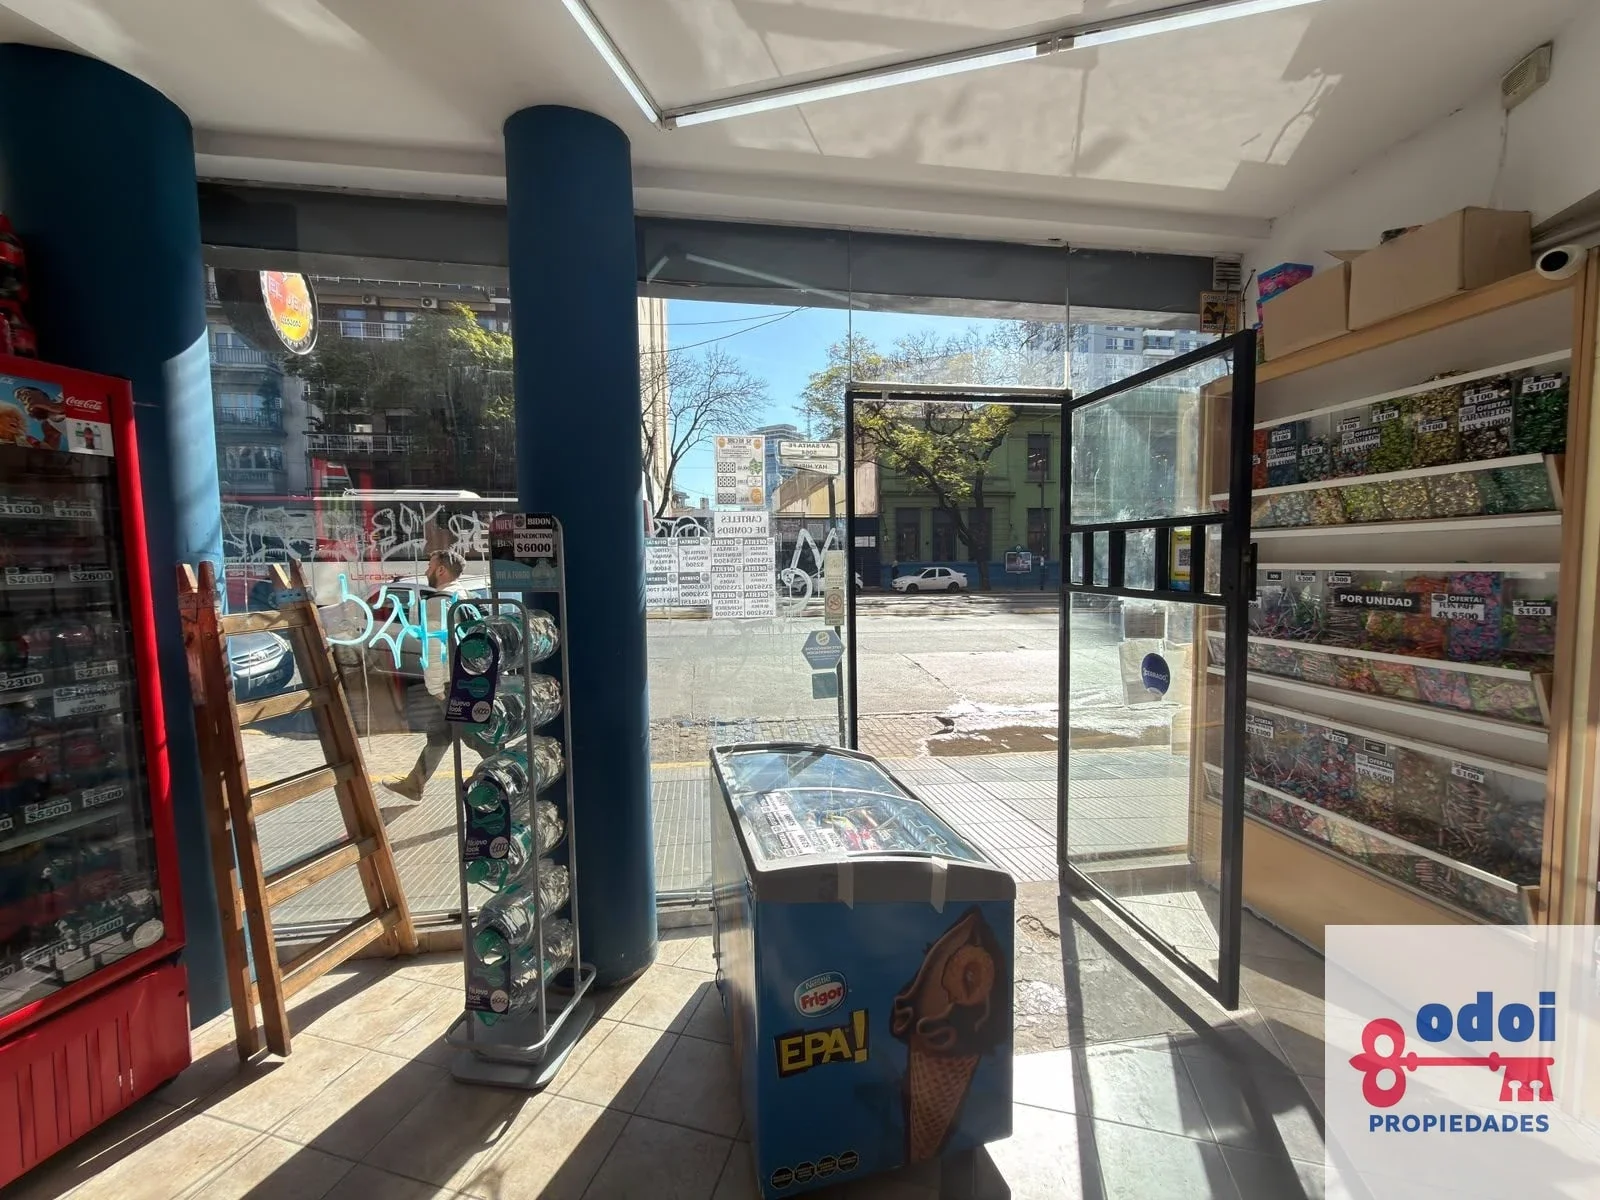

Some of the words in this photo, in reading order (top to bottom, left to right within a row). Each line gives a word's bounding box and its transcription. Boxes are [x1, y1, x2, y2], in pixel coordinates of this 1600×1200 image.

[1527, 381, 1556, 391] $100
[1468, 392, 1494, 403] $100
[1477, 400, 1511, 412] OFERTA!
[1375, 412, 1396, 421] $100
[1459, 408, 1512, 423] CARAMELOS
[1340, 423, 1357, 431] $100
[1420, 423, 1444, 431] $100
[1480, 417, 1512, 428] $1000
[1354, 428, 1379, 437] OFERTA!
[1342, 435, 1380, 445] CARAMELOS
[496, 520, 513, 529] NUEV
[516, 543, 551, 553] $6000
[74, 572, 112, 581] $2600
[1340, 594, 1363, 604] POR
[1366, 597, 1413, 607] UNIDAD
[1451, 611, 1478, 619] $500
[1518, 607, 1546, 615] $150
[1368, 758, 1393, 769] OFERTA!
[1372, 771, 1393, 782] $500
[1456, 769, 1480, 781] $100
[28, 804, 70, 821] $5500
[800, 987, 843, 1010] Frigor
[780, 1010, 868, 1072] EPA!
